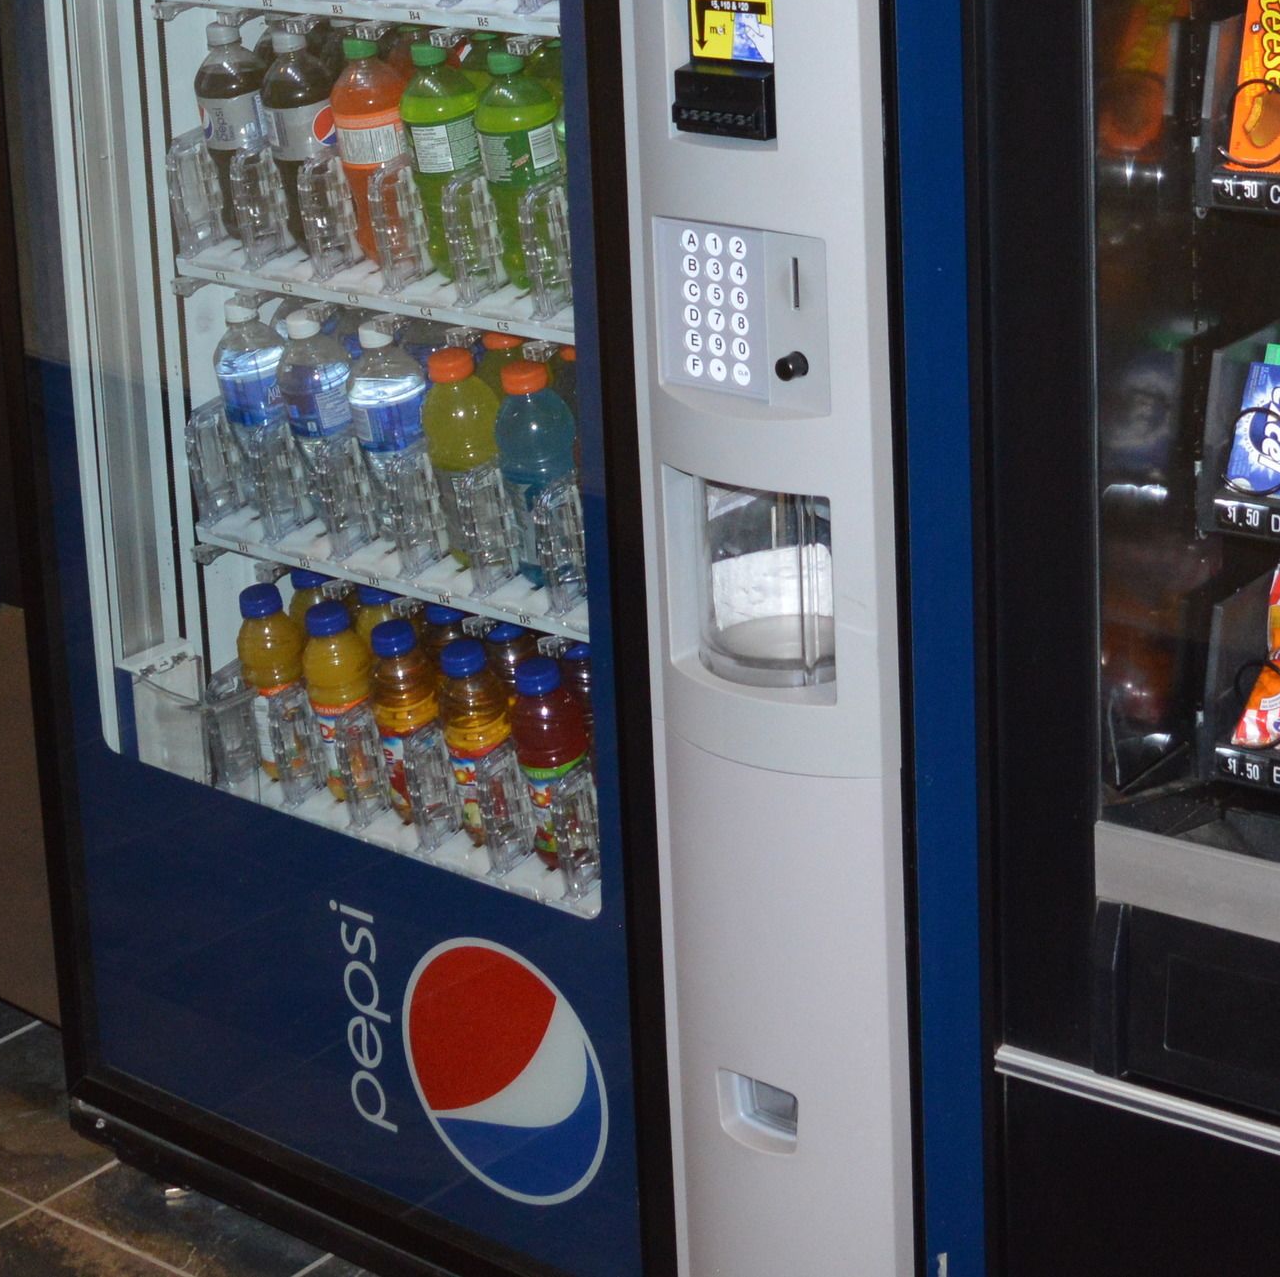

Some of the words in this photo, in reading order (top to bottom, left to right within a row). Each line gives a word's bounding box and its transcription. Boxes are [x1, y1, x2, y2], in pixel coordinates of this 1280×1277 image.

[332, 4, 344, 15] B3
[408, 10, 421, 21] B4
[477, 17, 490, 28] B5
[1223, 180, 1259, 200] $1.50
[687, 233, 697, 247] A
[734, 240, 743, 254] 2
[688, 258, 697, 271] B
[712, 262, 720, 275] 3
[735, 266, 744, 279] 4
[215, 271, 227, 282] C1
[281, 282, 293, 293] C2
[347, 293, 360, 304] C3
[419, 307, 433, 318] C4
[496, 321, 509, 332] C5
[688, 283, 698, 296] C
[713, 287, 721, 300] 5
[736, 291, 744, 304] 6
[690, 308, 699, 321] D
[713, 312, 722, 325] 7
[737, 316, 745, 330] 8
[691, 333, 700, 346] E
[714, 337, 723, 350] 9
[692, 358, 700, 371] F
[1227, 506, 1260, 528] $1.50
[368, 576, 380, 587] D3
[438, 594, 451, 605] D4
[518, 613, 531, 624] D5
[1227, 757, 1261, 781] $1.50
[328, 899, 399, 1134] pepsi
